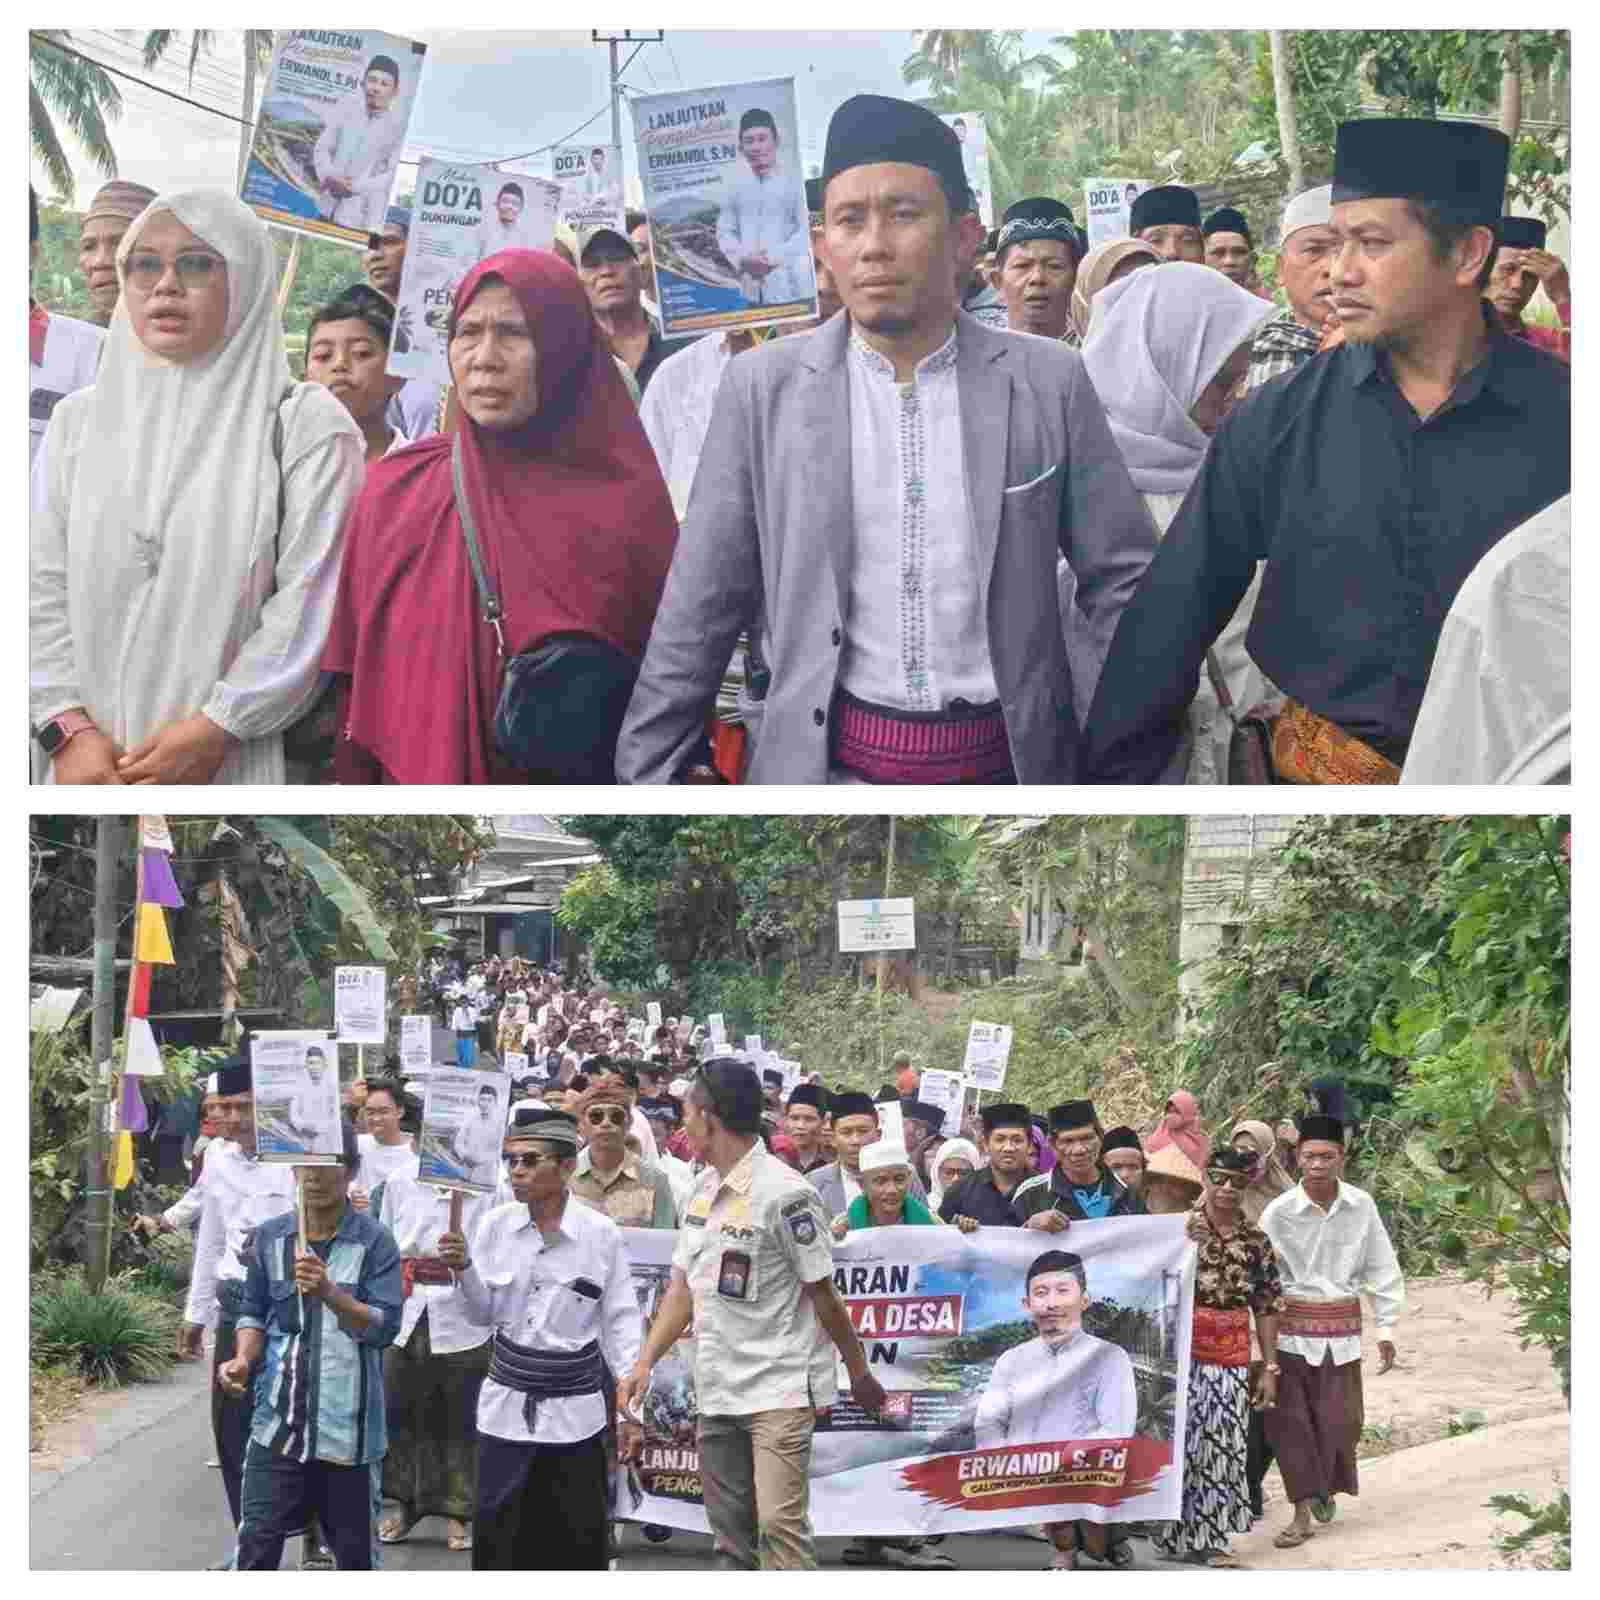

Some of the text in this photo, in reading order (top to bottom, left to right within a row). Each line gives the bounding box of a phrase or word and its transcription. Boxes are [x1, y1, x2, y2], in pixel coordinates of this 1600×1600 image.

[649, 100, 726, 129] LANJUTKAN
[554, 154, 585, 170] DO'A
[423, 181, 482, 210] DO'A
[420, 211, 482, 226] DUKUNGAN
[884, 1301, 955, 1333] DESA
